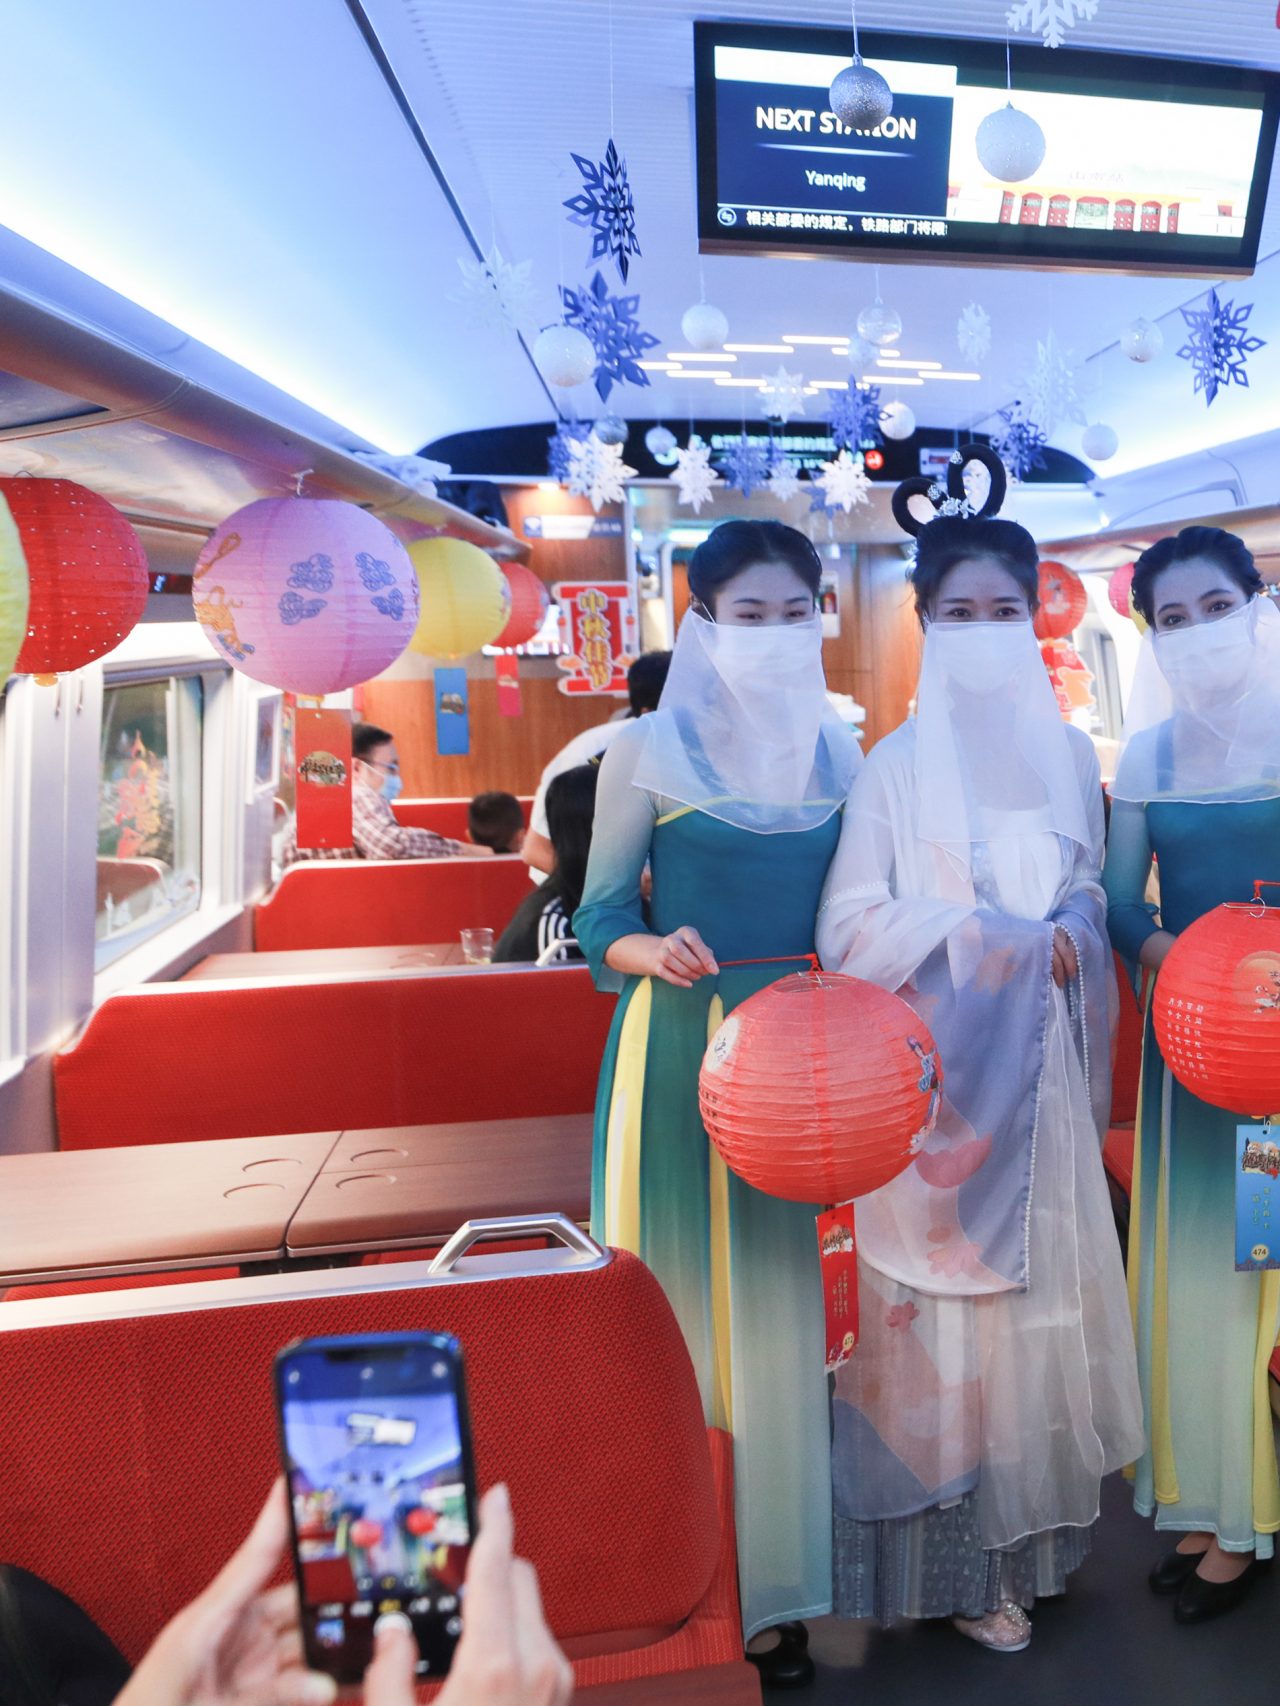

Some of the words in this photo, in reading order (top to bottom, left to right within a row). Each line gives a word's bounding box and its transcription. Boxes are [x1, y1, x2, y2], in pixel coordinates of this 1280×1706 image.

[756, 106, 816, 133] NEXT
[819, 111, 917, 140] STON
[805, 169, 866, 192] Yanqing
[1252, 1248, 1267, 1257] 474
